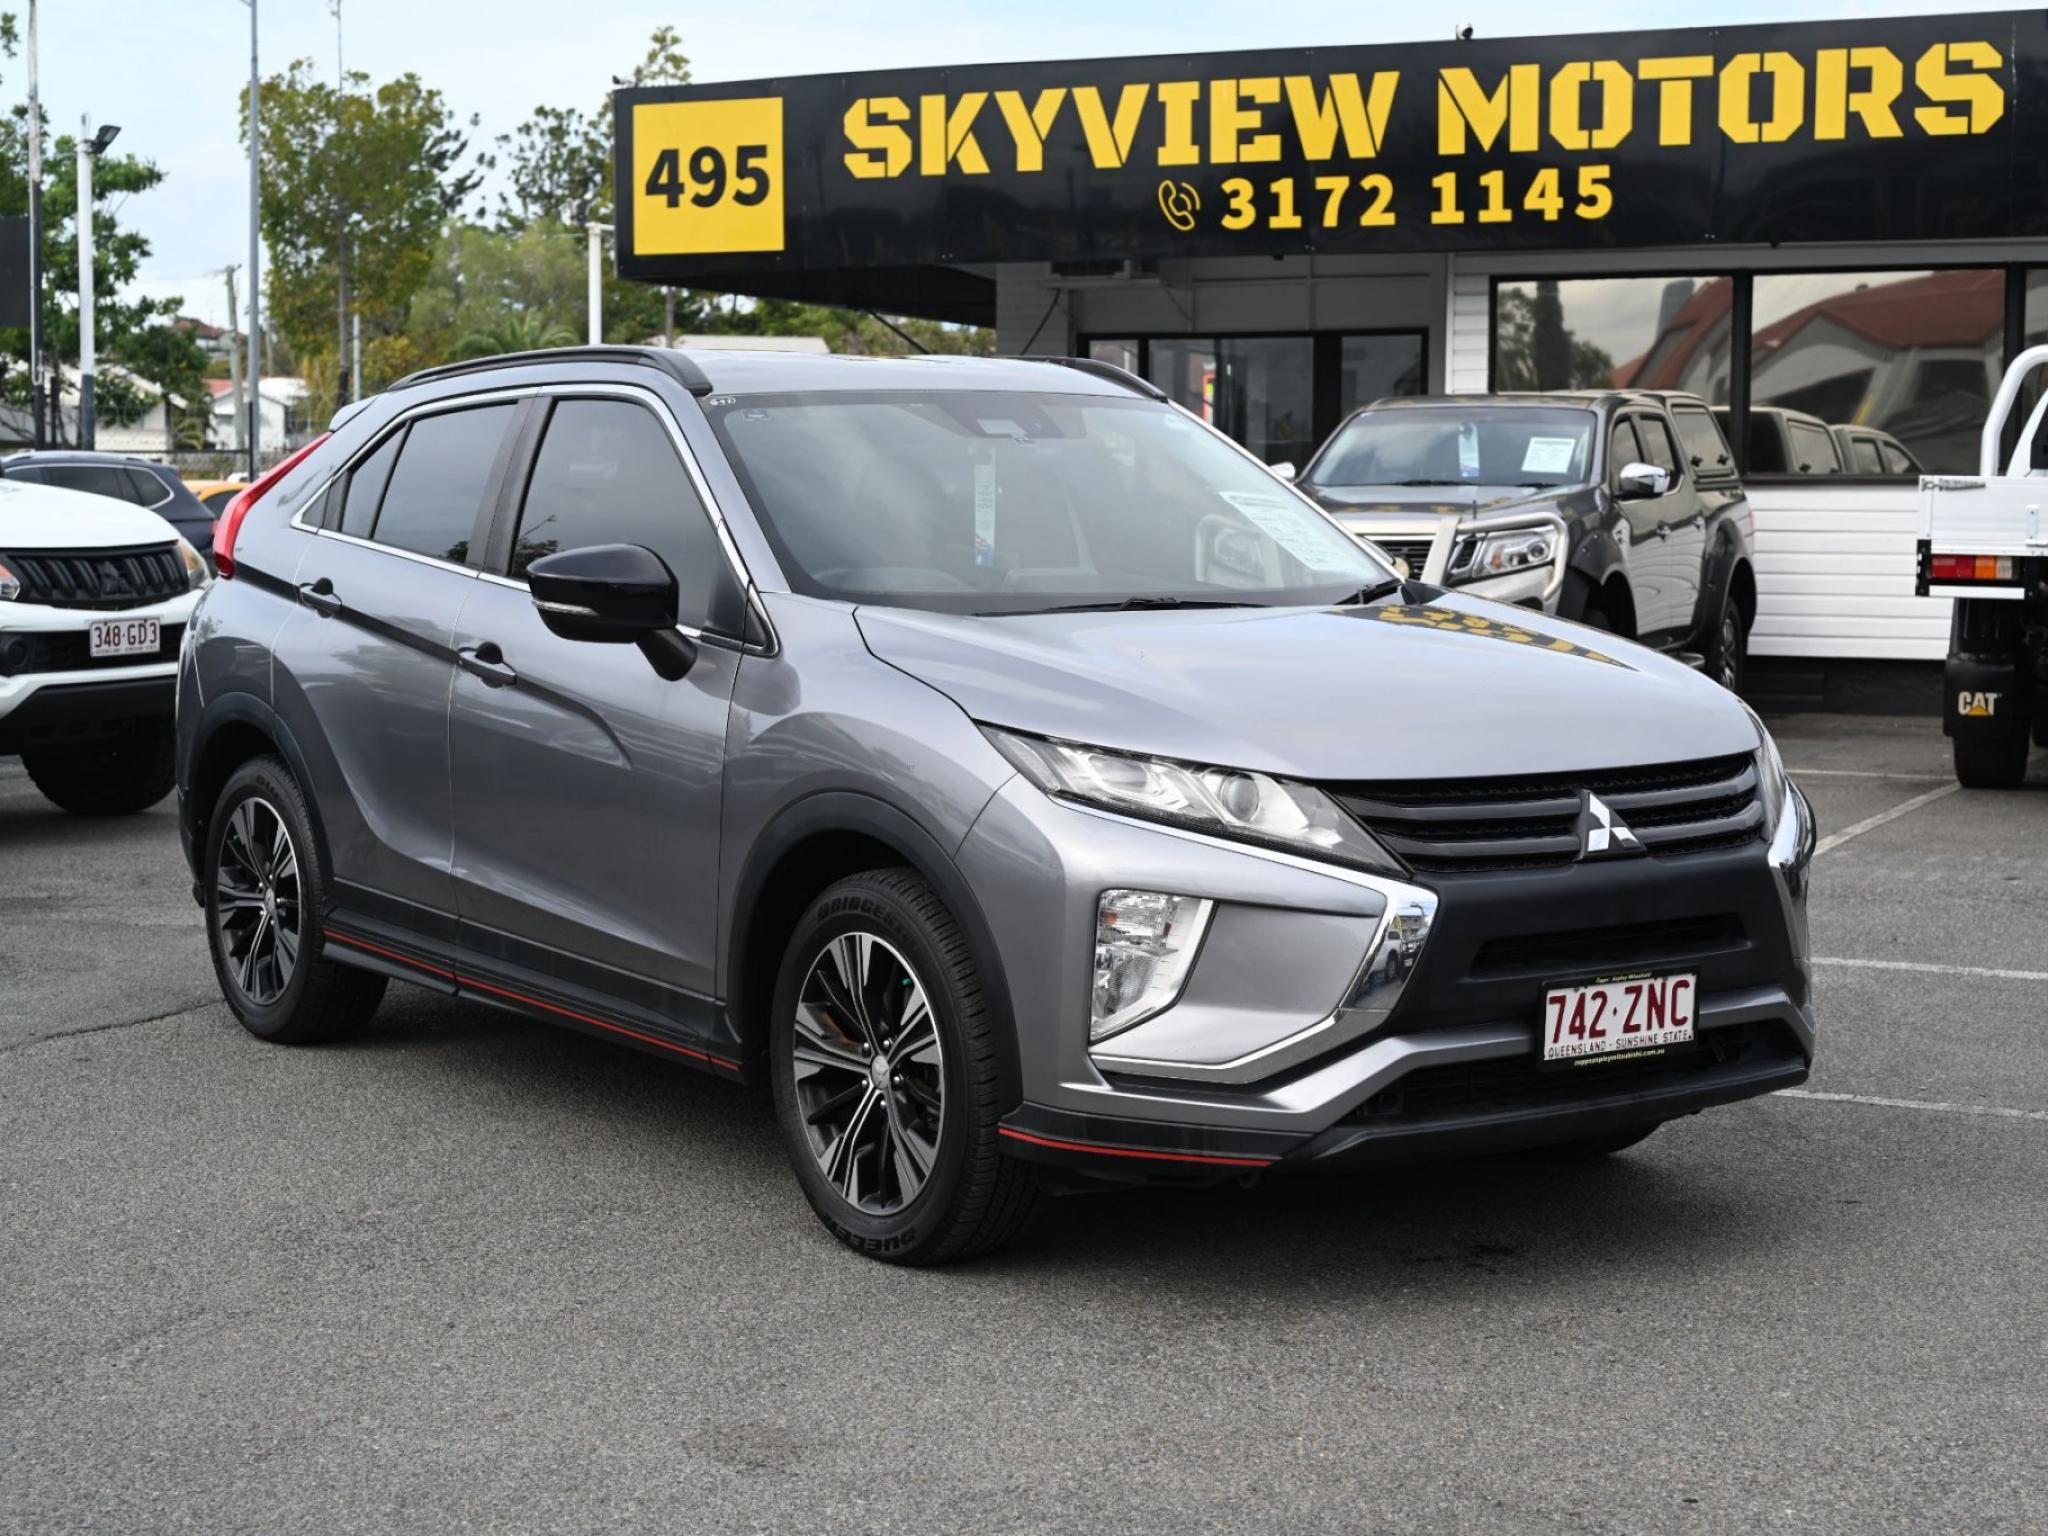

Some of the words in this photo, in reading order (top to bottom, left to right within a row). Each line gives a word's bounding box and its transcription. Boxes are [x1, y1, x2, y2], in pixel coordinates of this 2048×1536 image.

[843, 71, 1400, 178] SKYVIEW
[1438, 41, 2004, 156] MOTORS
[644, 144, 770, 209] 495
[1220, 174, 1396, 230] 3172
[1430, 165, 1614, 225] 1145
[1958, 691, 1998, 716] CAT
[1547, 1040, 1606, 1058] QUEENSLAND
[1615, 1034, 1658, 1050] SUNSHINE
[1663, 1029, 1688, 1043] STATE
